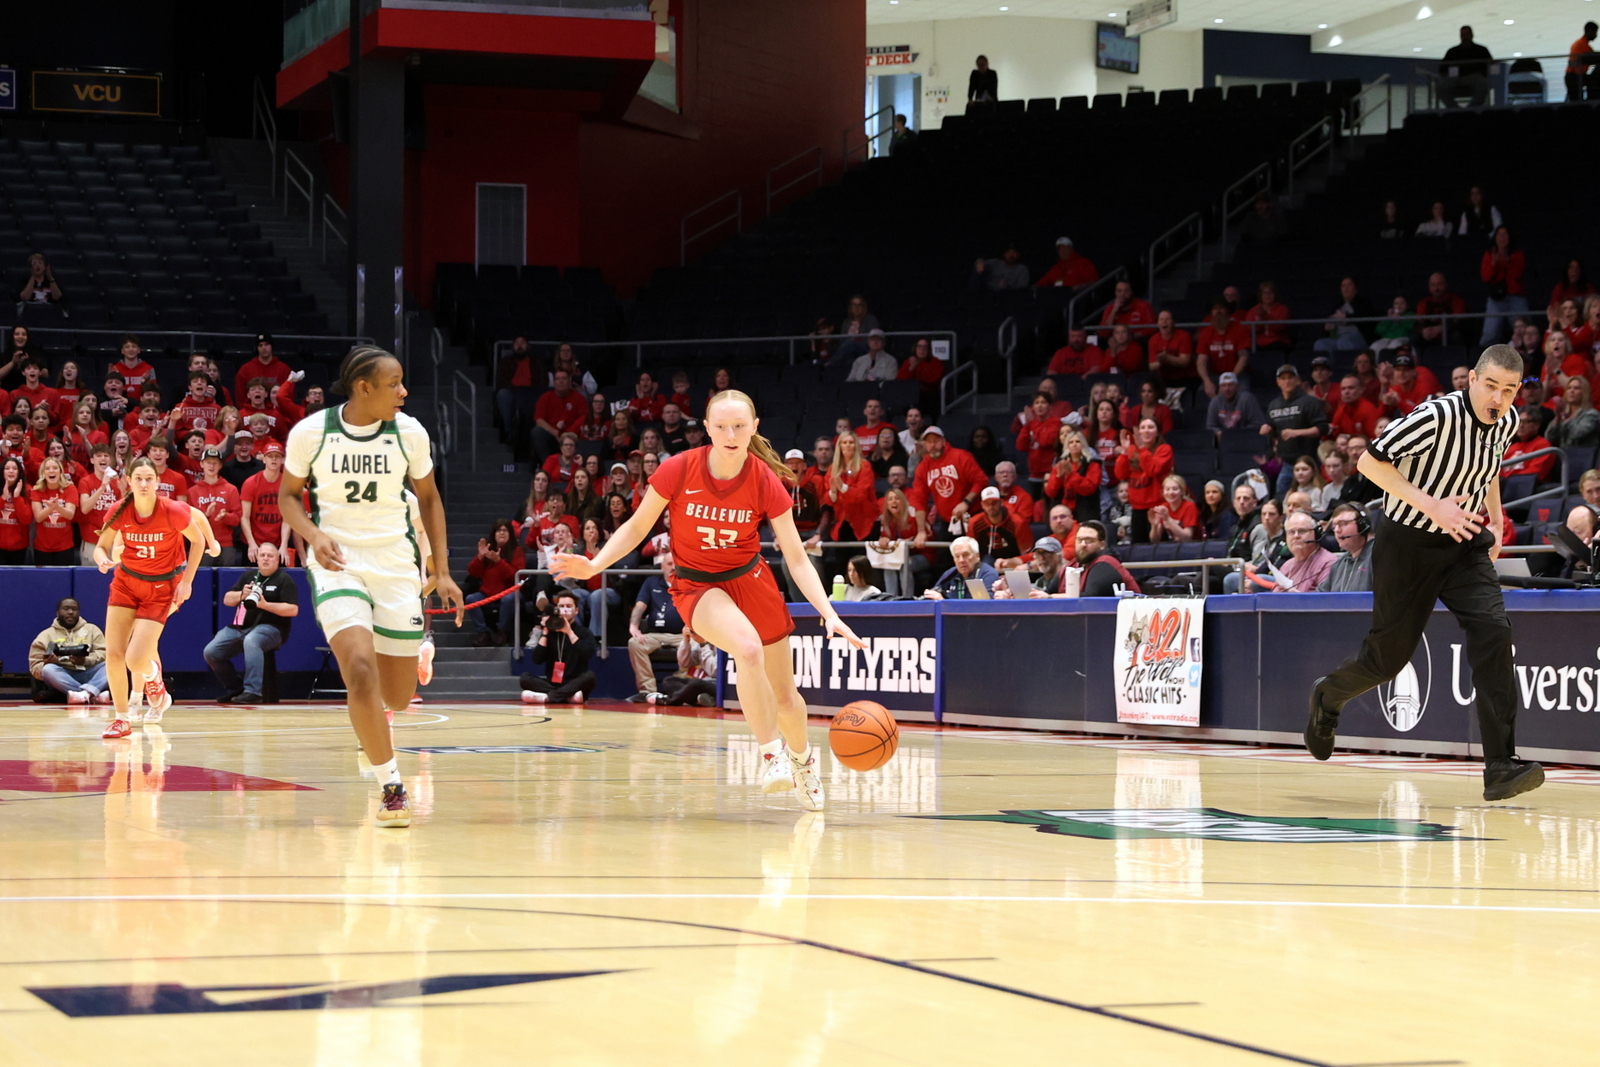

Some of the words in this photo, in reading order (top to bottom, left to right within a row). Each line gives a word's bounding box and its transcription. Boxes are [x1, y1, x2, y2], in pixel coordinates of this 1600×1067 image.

[876, 52, 911, 66] DECK
[73, 84, 121, 102] VCU
[331, 453, 391, 474] LAUREL
[257, 493, 279, 505] STAT
[344, 480, 378, 503] 24
[685, 502, 753, 523] BELLEVUE
[126, 532, 164, 543] BELLEVUE
[135, 545, 156, 559] 21
[828, 636, 936, 693] FLYERS
[1124, 664, 1146, 687] The
[1450, 643, 1600, 713] Uvers
[1161, 687, 1182, 704] HITS
